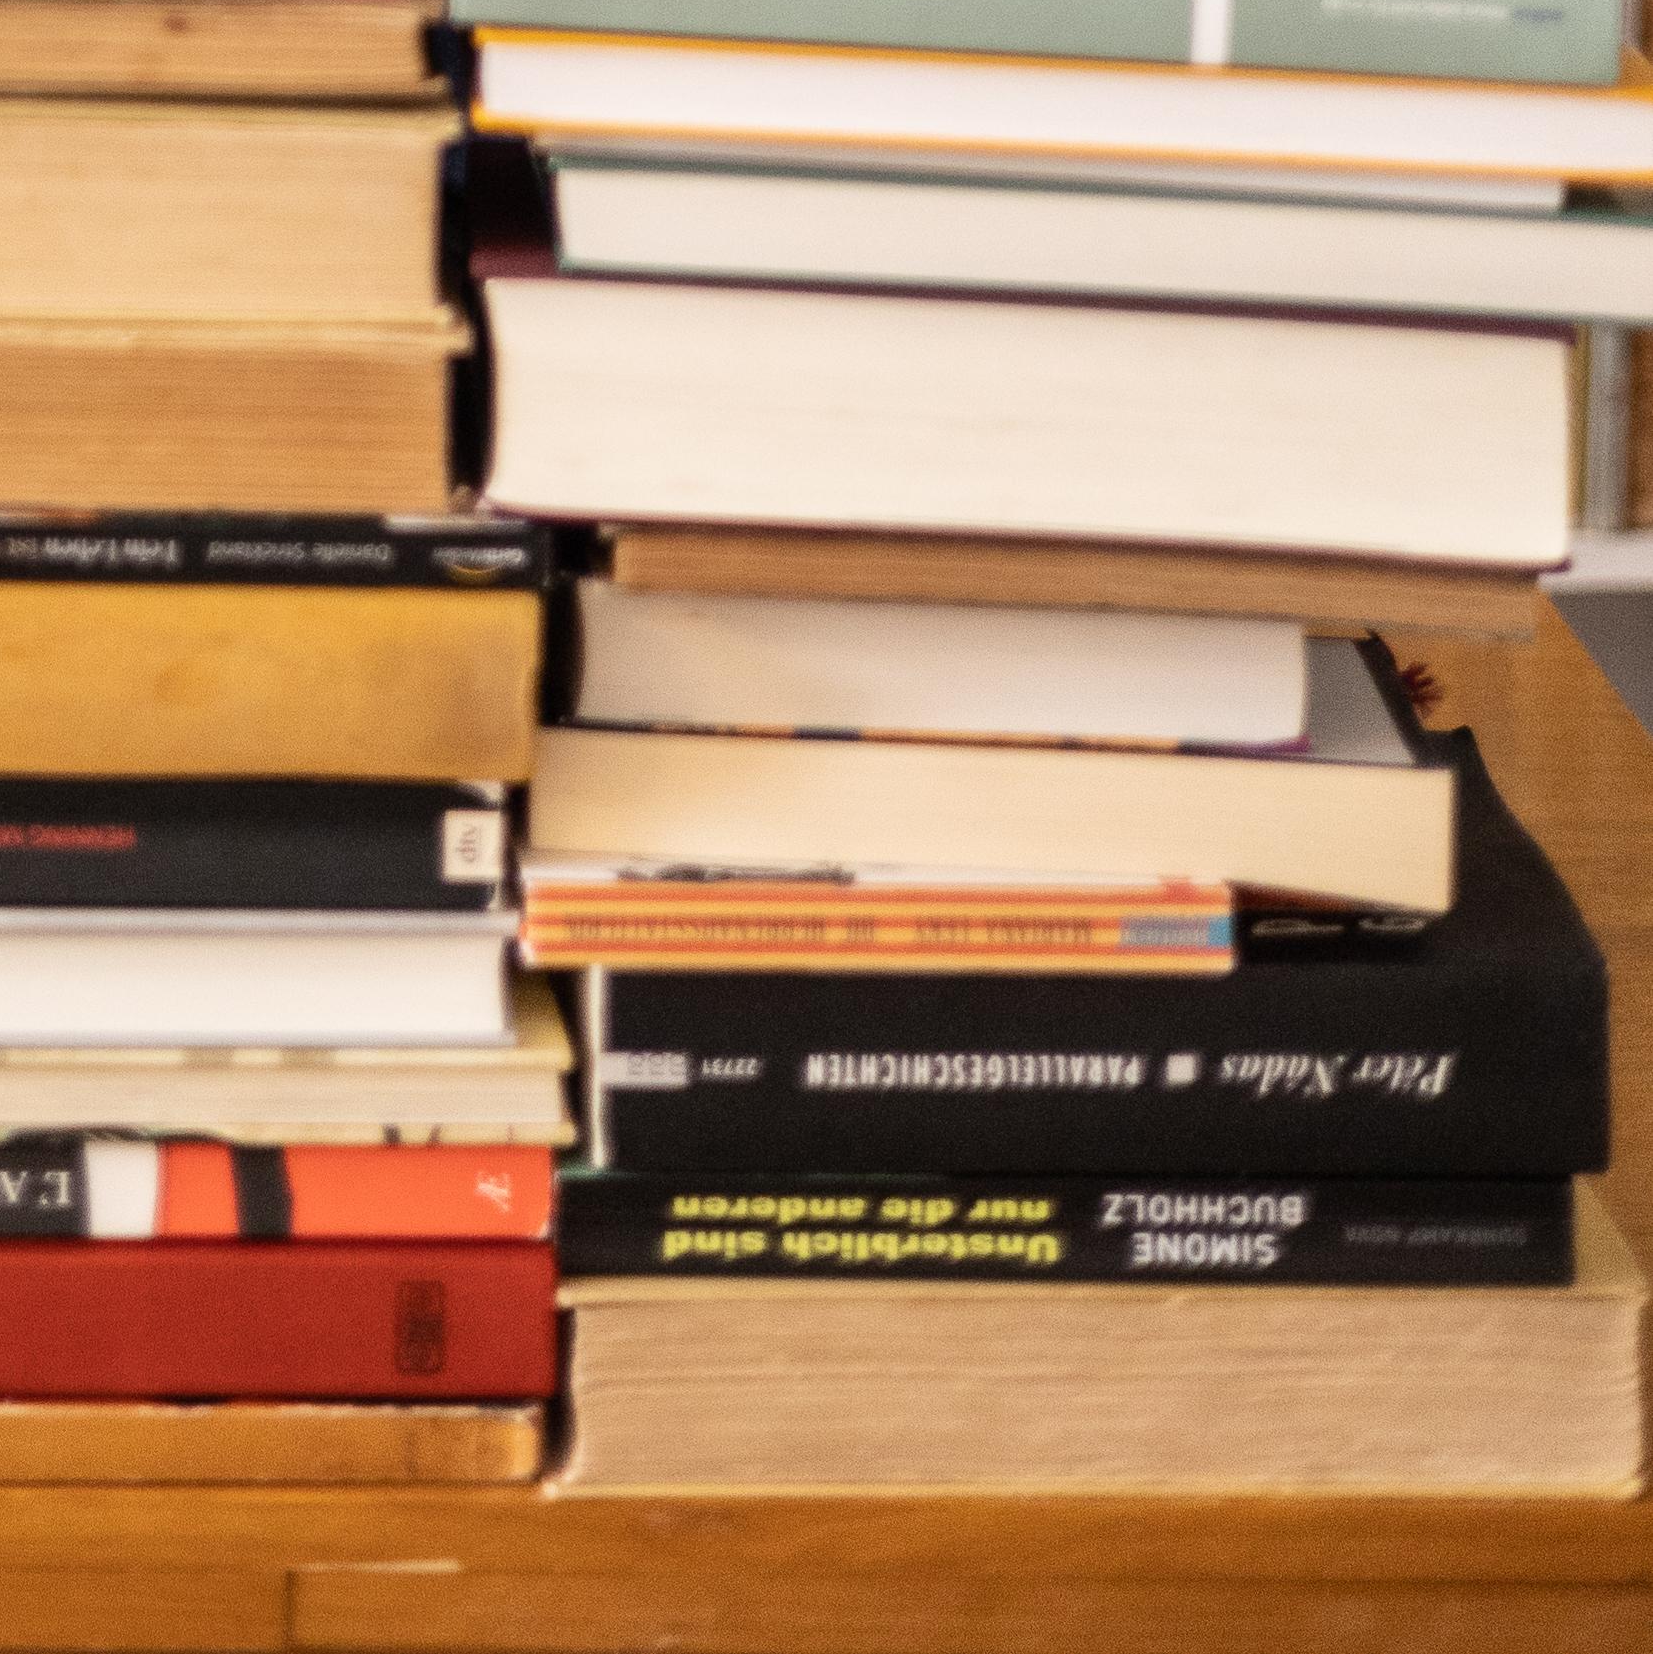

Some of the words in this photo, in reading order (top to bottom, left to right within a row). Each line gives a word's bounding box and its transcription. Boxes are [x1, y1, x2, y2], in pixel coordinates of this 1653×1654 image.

[803, 1049, 1144, 1089] PARALLELGESCHICHTEN
[1216, 1051, 1347, 1099] Nádas
[1352, 1051, 1460, 1097] Péter
[669, 1192, 868, 1225] anderen
[878, 1192, 956, 1225] die
[965, 1194, 1054, 1224] nur
[1100, 1191, 1308, 1230] BUCHHOLZ
[661, 1227, 769, 1263] sind
[779, 1229, 1063, 1265] Unsterblich
[1129, 1229, 1282, 1267] SIMONE
